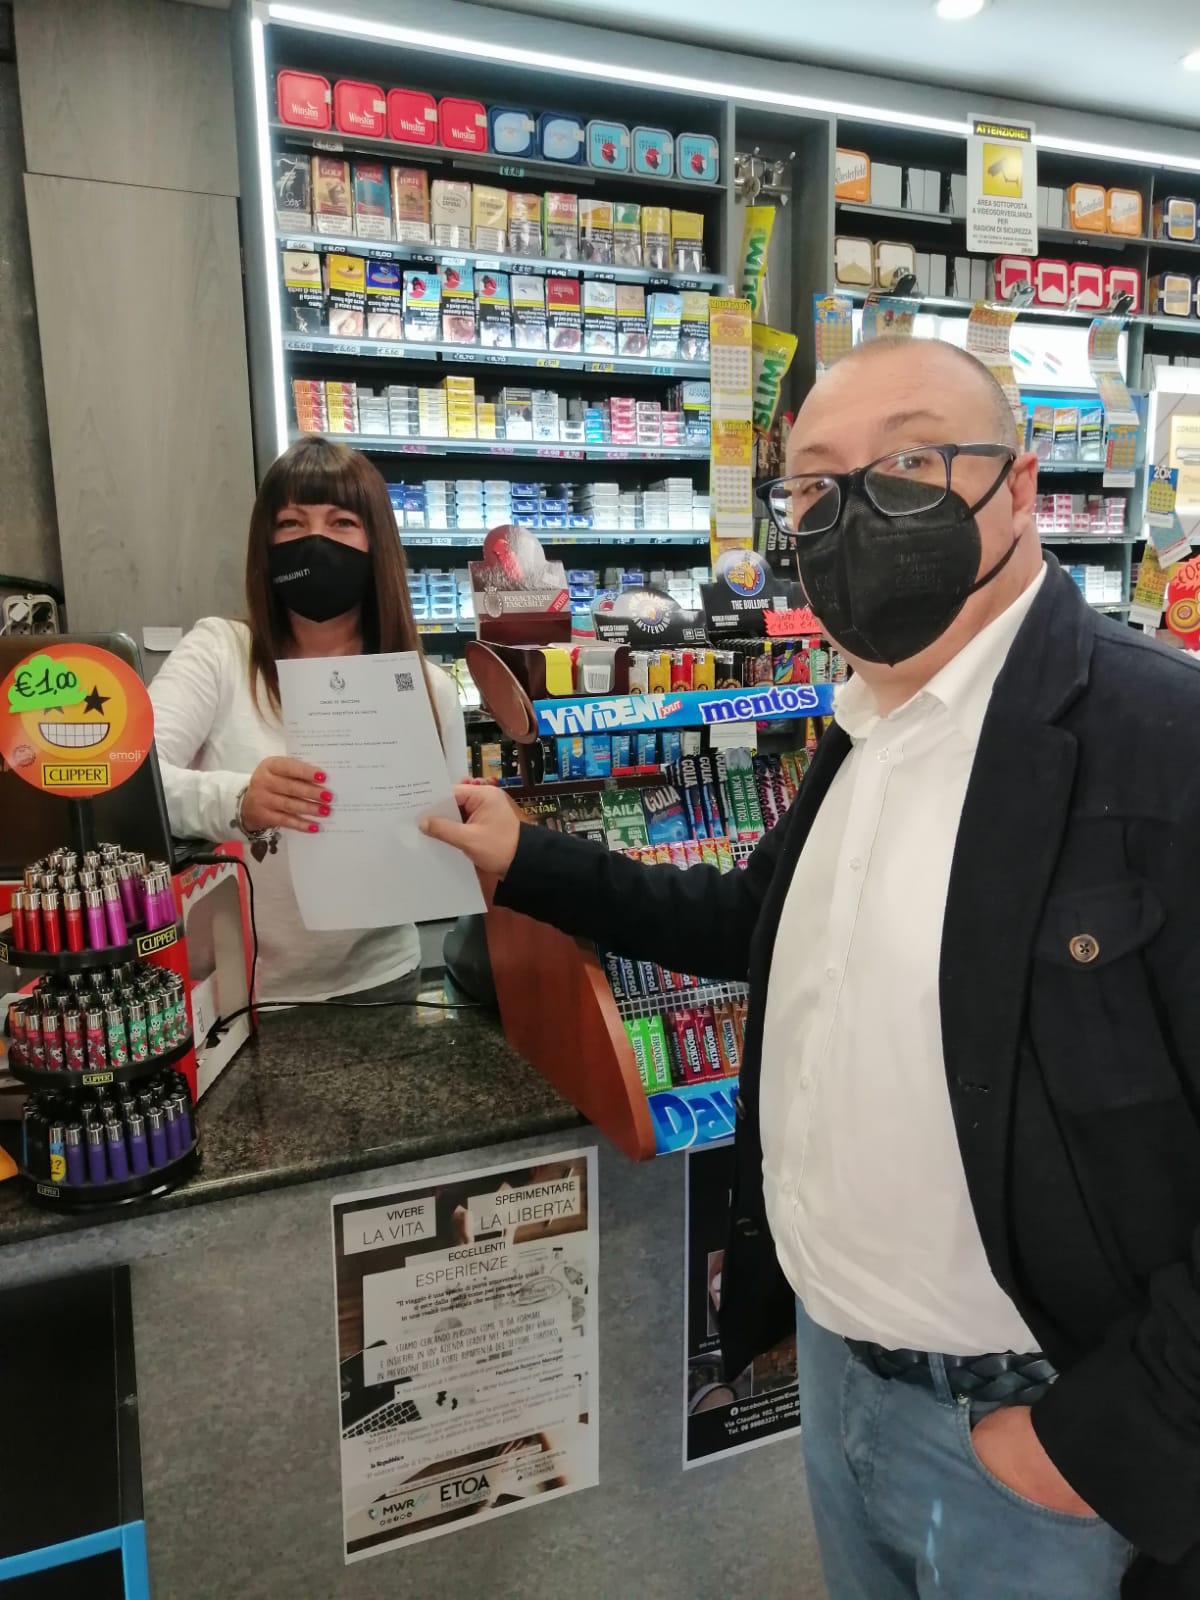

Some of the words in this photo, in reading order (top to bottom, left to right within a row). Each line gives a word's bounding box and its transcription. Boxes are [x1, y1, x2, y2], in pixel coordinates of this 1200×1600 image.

[976, 124, 1029, 139] ATTENZIONE!
[993, 201, 1028, 210] SOTTOPOSTA
[973, 225, 995, 233] RAGIONI
[1003, 227, 1032, 235] SICUREZZA
[753, 358, 786, 428] SLIM
[731, 600, 742, 610] THE
[743, 599, 770, 610] BULLDOG
[700, 686, 818, 726] mentos
[110, 750, 141, 762] emoji
[50, 768, 102, 782] CLIPPER
[682, 760, 698, 788] GOLIA
[700, 756, 713, 784] GOLIA
[604, 803, 642, 818] SAILA
[141, 930, 176, 951] CLIPPER
[685, 1028, 700, 1073] BROOKLYN
[705, 1025, 720, 1070] BROOKLYN
[724, 1021, 738, 1065] BROOKLYN
[652, 1033, 666, 1081] BROOKLYN
[496, 1181, 576, 1206] SPERIMENTARE
[386, 1205, 424, 1221] VIVERE
[480, 1213, 502, 1230] LA
[363, 1229, 384, 1245] LA
[389, 1221, 424, 1240] VITA
[448, 1241, 506, 1262] ECCELLENTI
[416, 1256, 508, 1288] ESPERIENZE
[440, 1474, 490, 1502] ETOA
[383, 1498, 414, 1516] MWR
